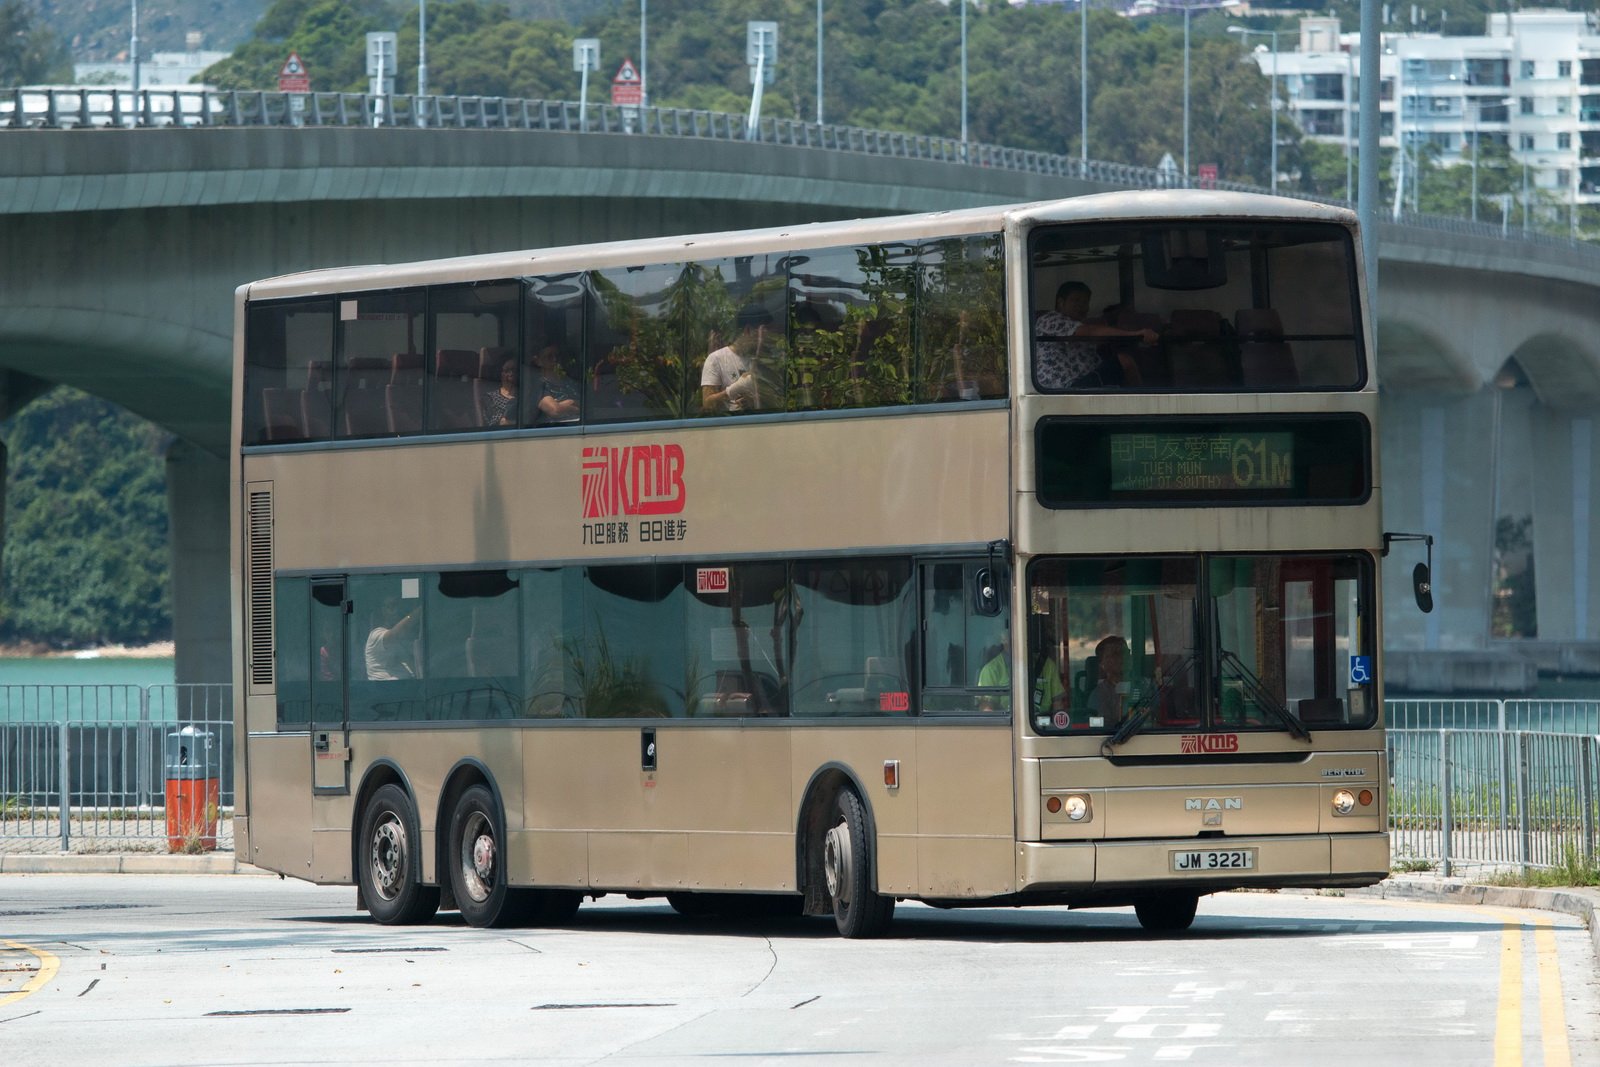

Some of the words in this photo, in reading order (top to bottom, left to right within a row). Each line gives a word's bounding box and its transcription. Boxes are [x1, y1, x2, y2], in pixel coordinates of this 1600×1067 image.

[1141, 461, 1173, 475] TUEN
[1178, 461, 1202, 475] MUN
[1232, 438, 1291, 487] 61M
[611, 444, 685, 515] KMB
[582, 521, 629, 544] 九巴服務
[640, 519, 686, 542] 日日進步
[706, 570, 727, 590] KMB
[887, 692, 909, 711] KMB
[1197, 734, 1239, 752] KMB
[1185, 798, 1241, 810] MAN
[1179, 853, 1201, 868] JM
[1208, 852, 1246, 867] 3221
